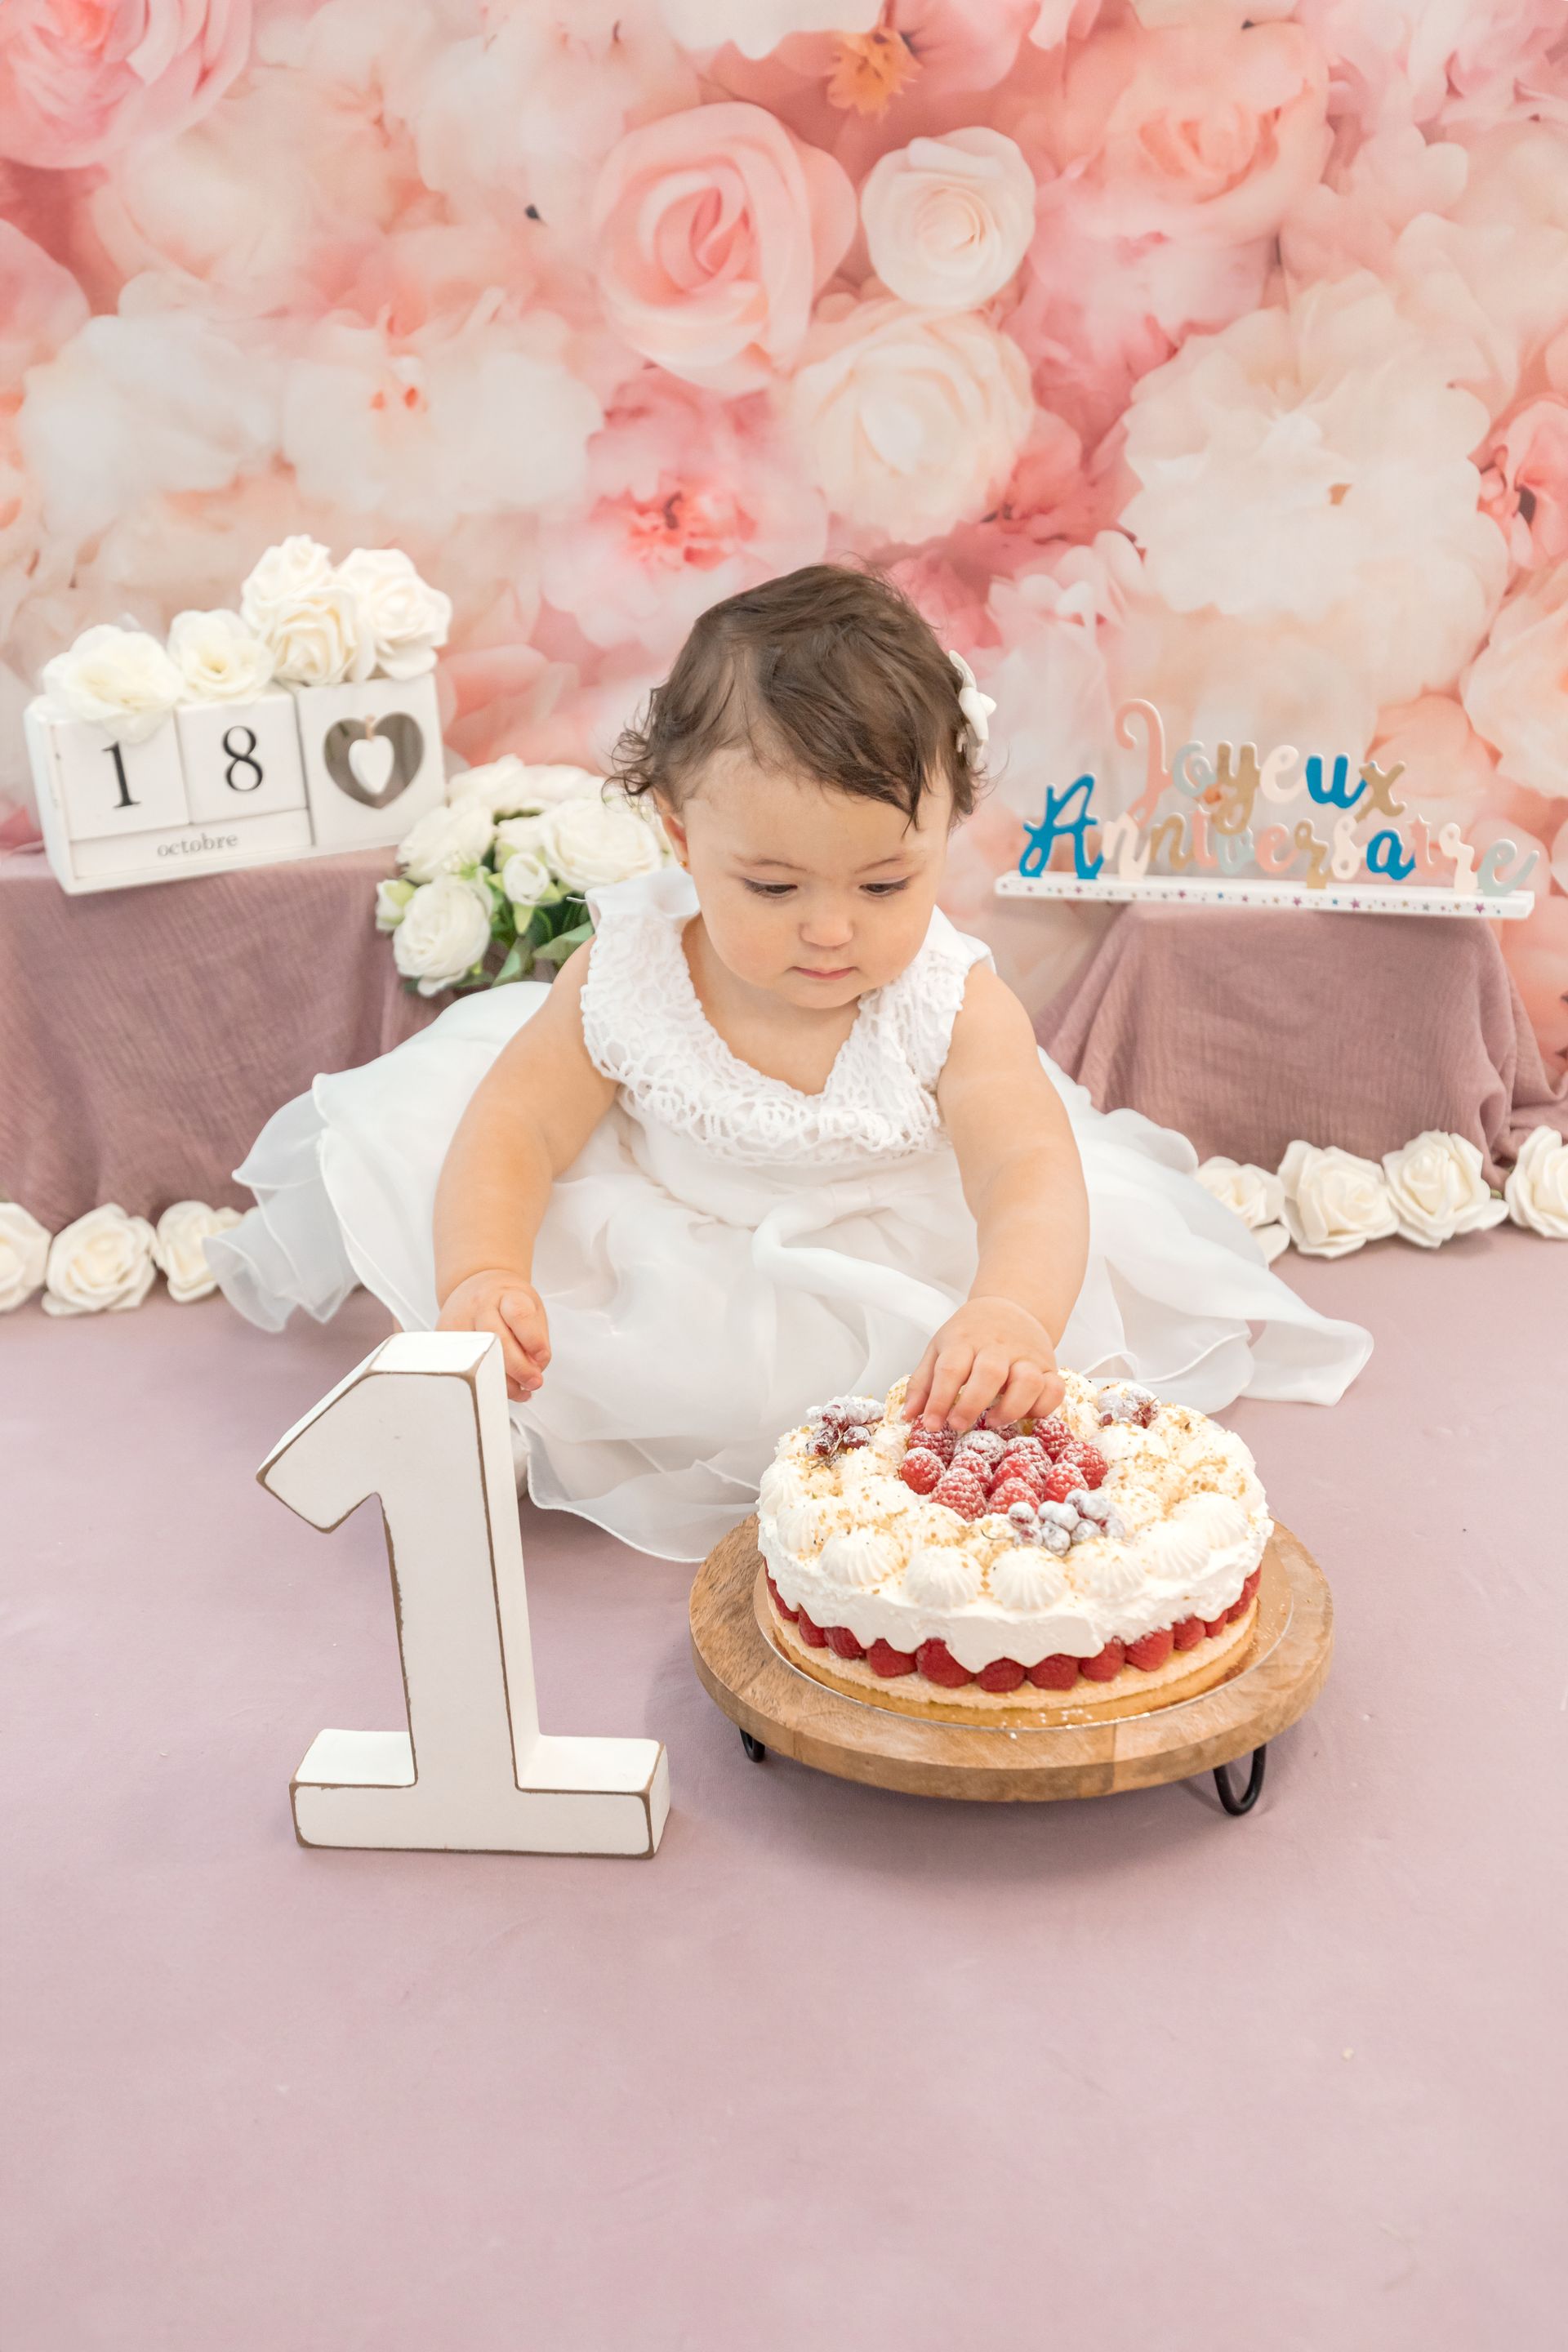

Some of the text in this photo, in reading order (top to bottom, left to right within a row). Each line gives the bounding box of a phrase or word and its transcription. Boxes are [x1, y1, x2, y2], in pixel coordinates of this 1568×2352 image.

[1114, 699, 1407, 834] Joyeux
[157, 833, 238, 857] octobre
[1018, 773, 1539, 896] Anniversaire
[256, 1331, 670, 1860] 1
